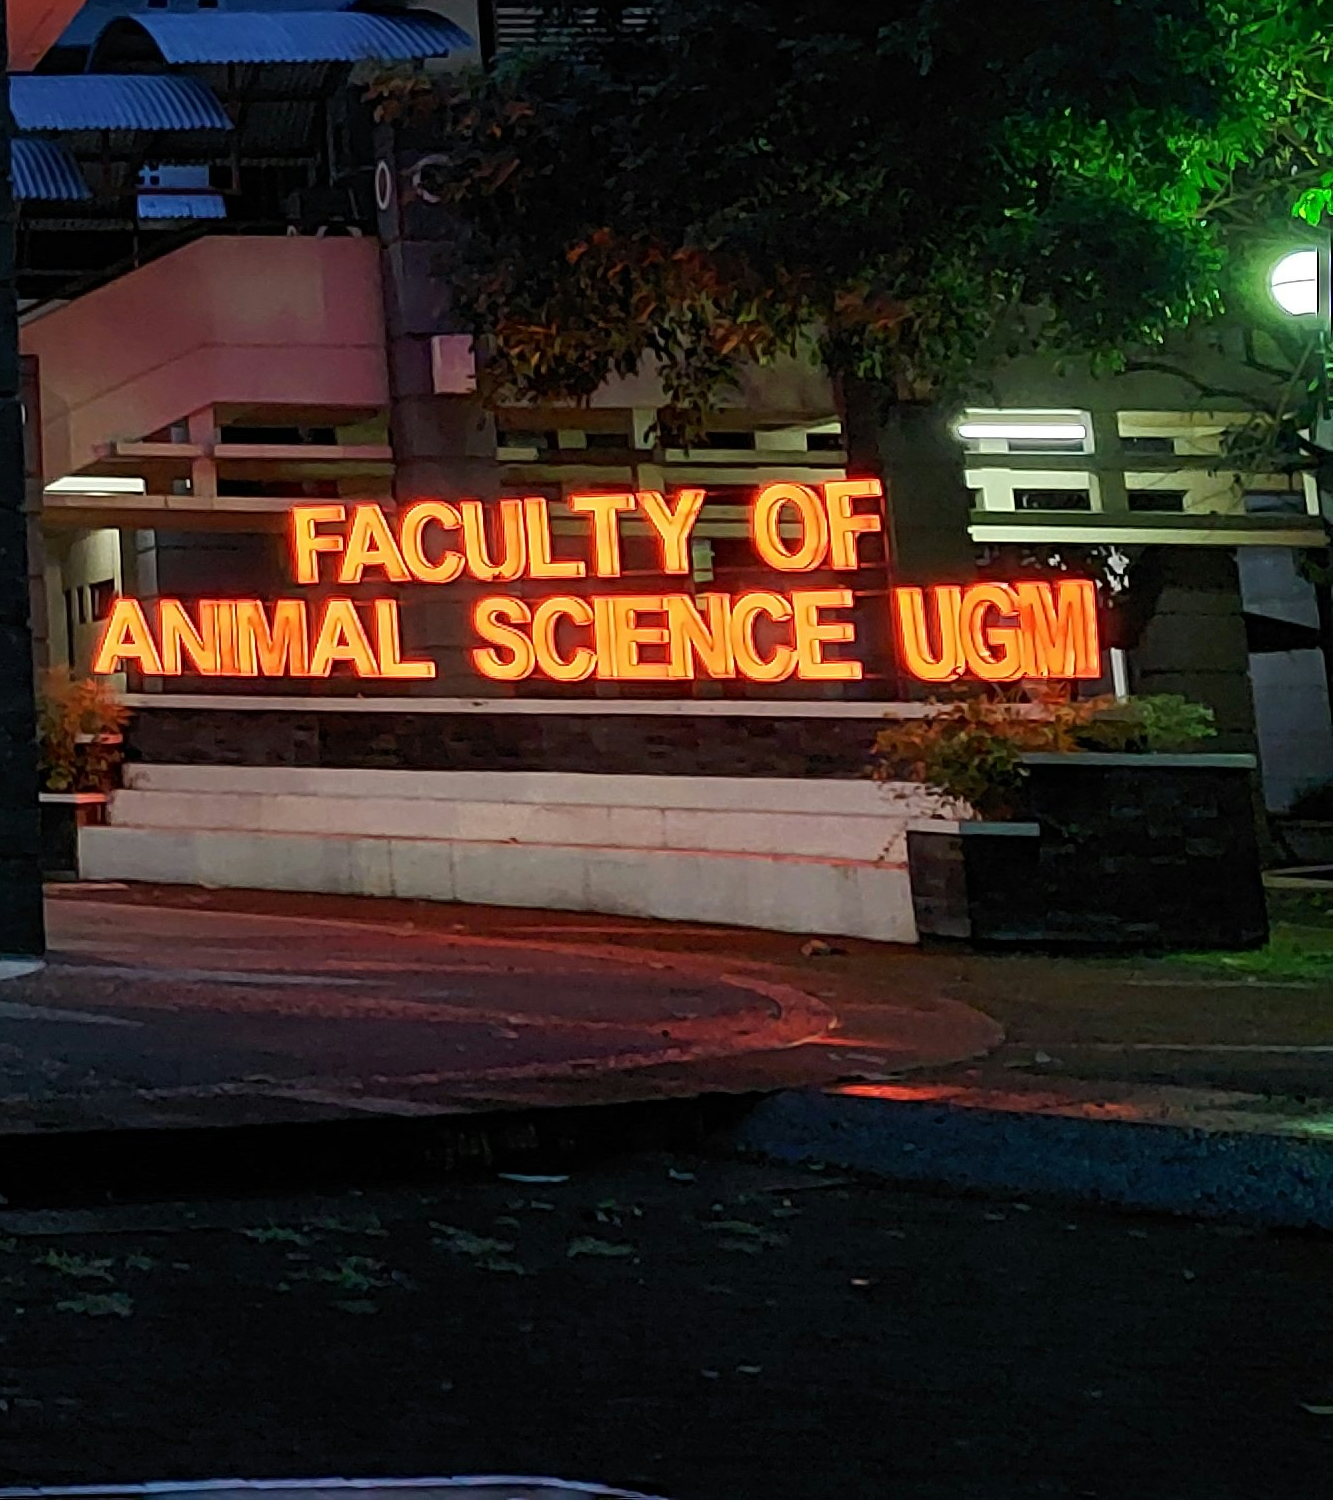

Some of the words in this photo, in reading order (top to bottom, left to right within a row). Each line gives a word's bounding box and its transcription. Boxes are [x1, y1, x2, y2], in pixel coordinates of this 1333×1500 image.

[291, 487, 705, 585] FACULTY
[751, 477, 883, 572] OF
[93, 596, 436, 679] ANIMAL
[472, 588, 863, 683] SCIENCE
[895, 579, 1102, 682] UGM
